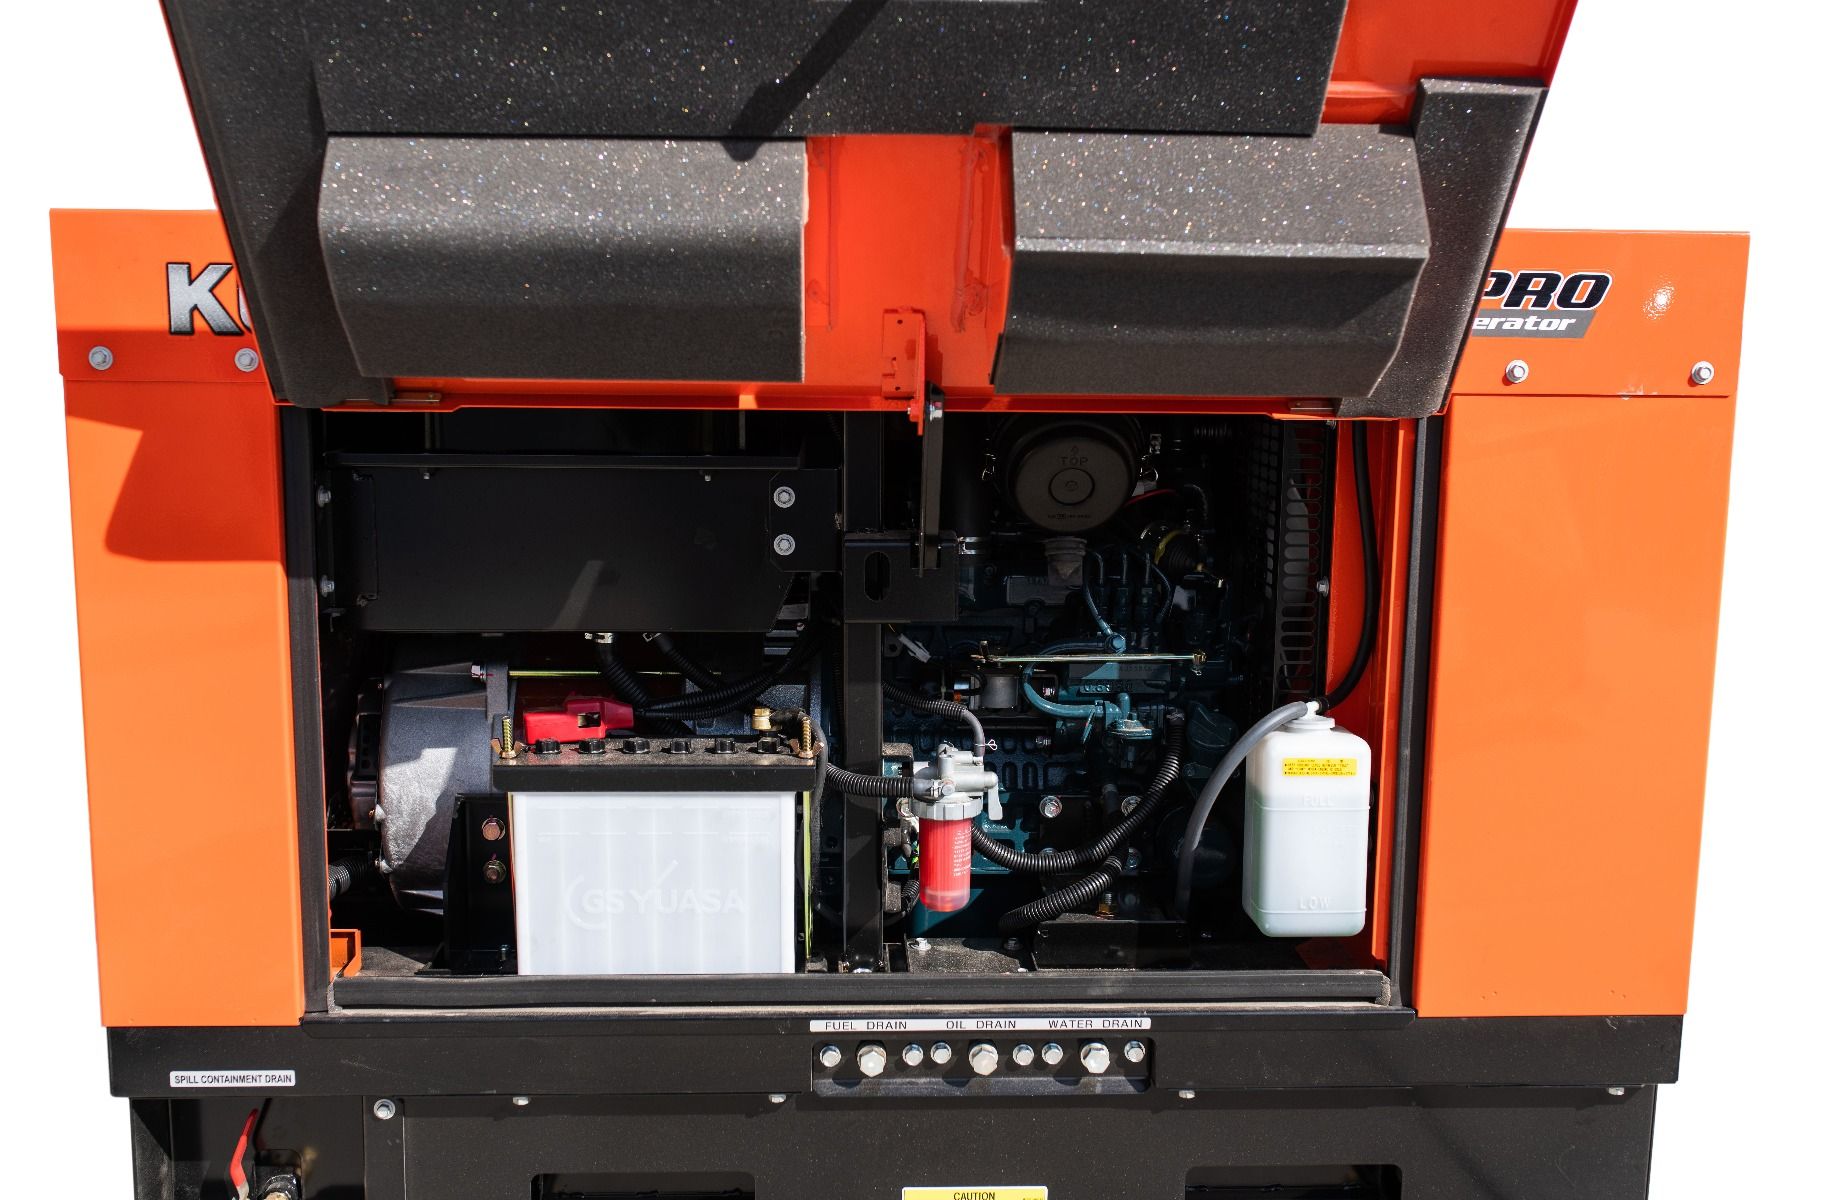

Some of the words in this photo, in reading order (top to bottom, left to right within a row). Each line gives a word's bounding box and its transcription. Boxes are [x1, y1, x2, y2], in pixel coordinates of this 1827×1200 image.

[1482, 270, 1613, 310] PRO
[1061, 456, 1088, 466] TOP
[1303, 793, 1336, 808] FULL
[581, 889, 625, 914] GS
[628, 888, 747, 914] YUASA
[1299, 896, 1329, 910] LOW
[825, 1021, 857, 1031] FUEL
[866, 1021, 907, 1030] DRAIN
[946, 1020, 966, 1030] OIL
[976, 1020, 1016, 1029] DRAIN
[1048, 1020, 1093, 1029] WATER
[1102, 1019, 1143, 1028] DRAIN
[174, 1075, 199, 1084] SPILL
[200, 1075, 262, 1084] CONTAINMENT
[265, 1074, 292, 1083] DRAIN
[953, 1192, 996, 1200] CAUTION
